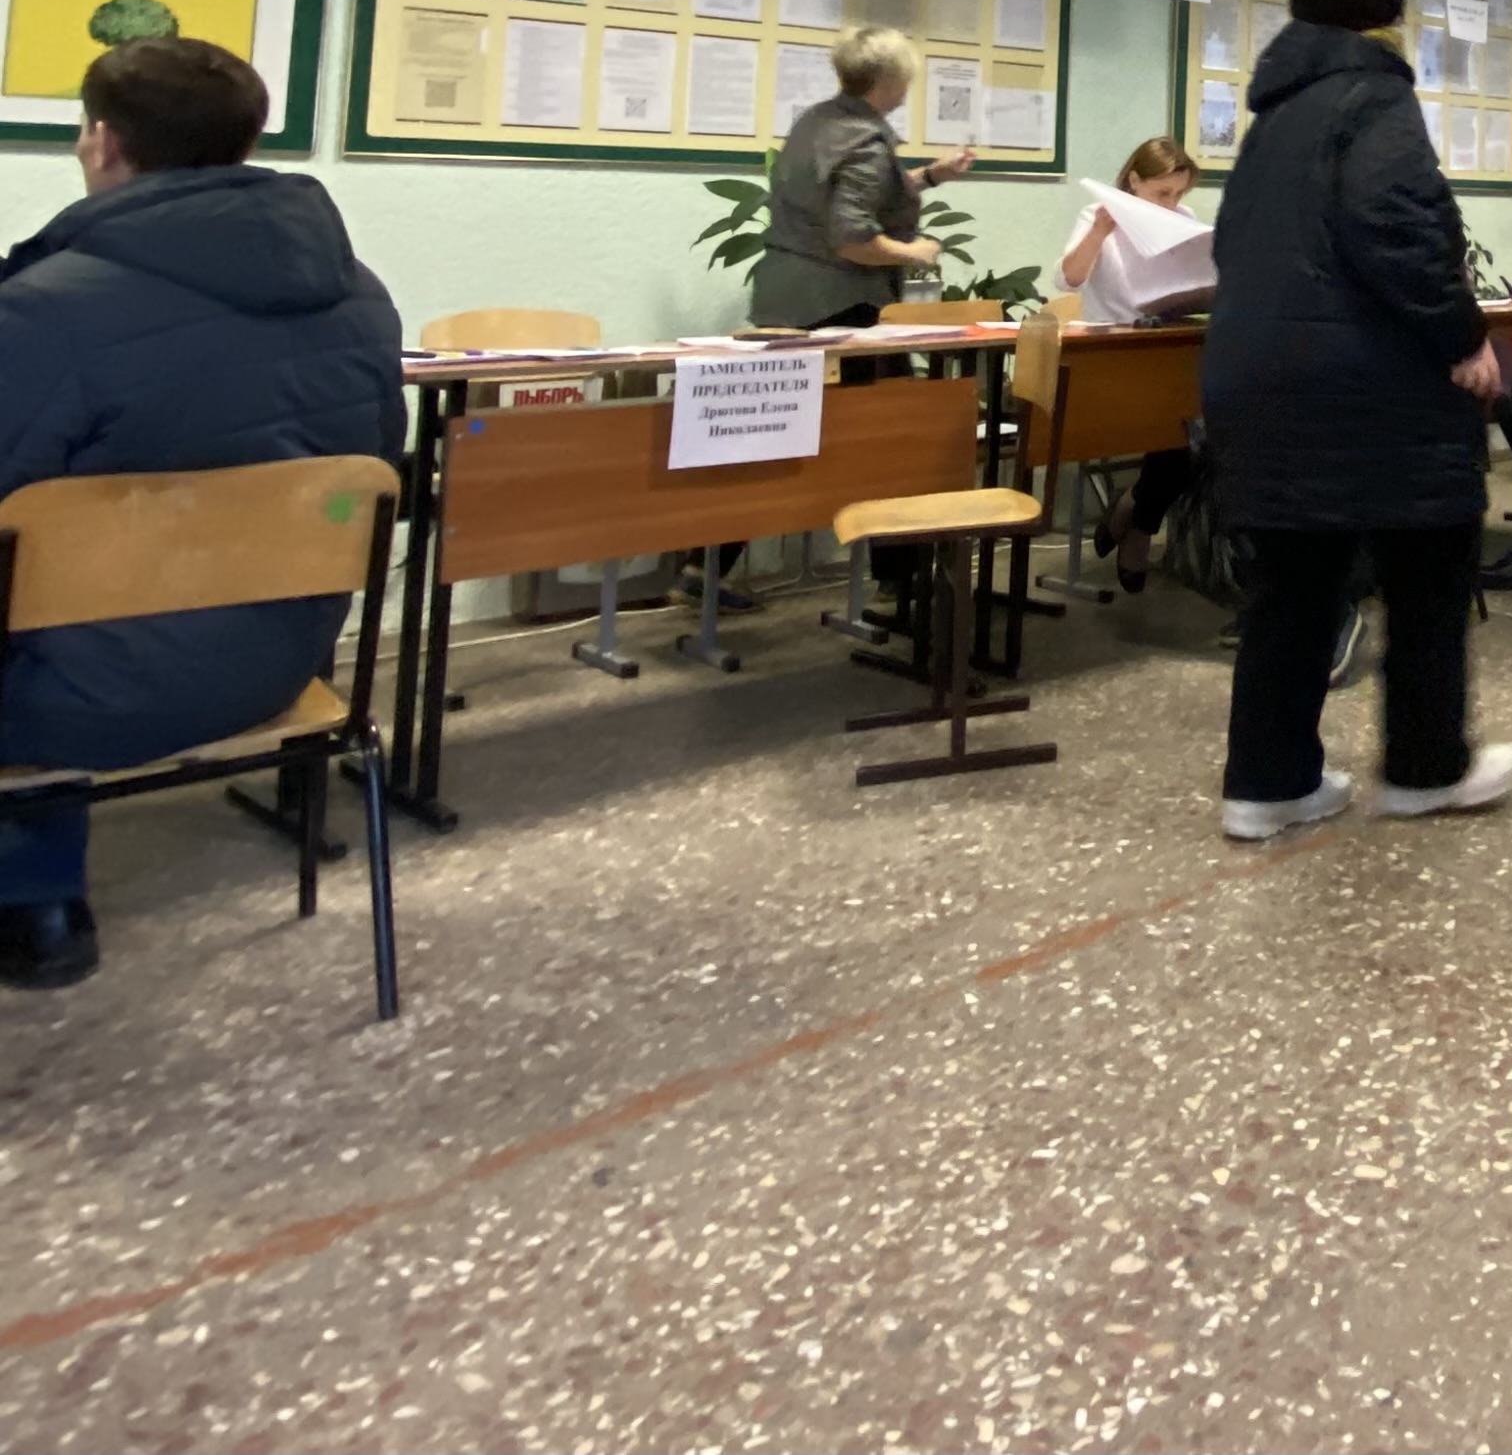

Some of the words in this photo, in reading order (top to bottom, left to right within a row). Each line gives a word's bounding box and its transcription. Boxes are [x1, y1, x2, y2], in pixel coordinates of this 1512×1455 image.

[700, 359, 807, 375] ЗАМЕСТИТЕЛЬ
[692, 379, 809, 398] ПРЕДСЕДАТЕЛЯ
[761, 402, 798, 414] Елена
[708, 422, 787, 438] Николаевна
